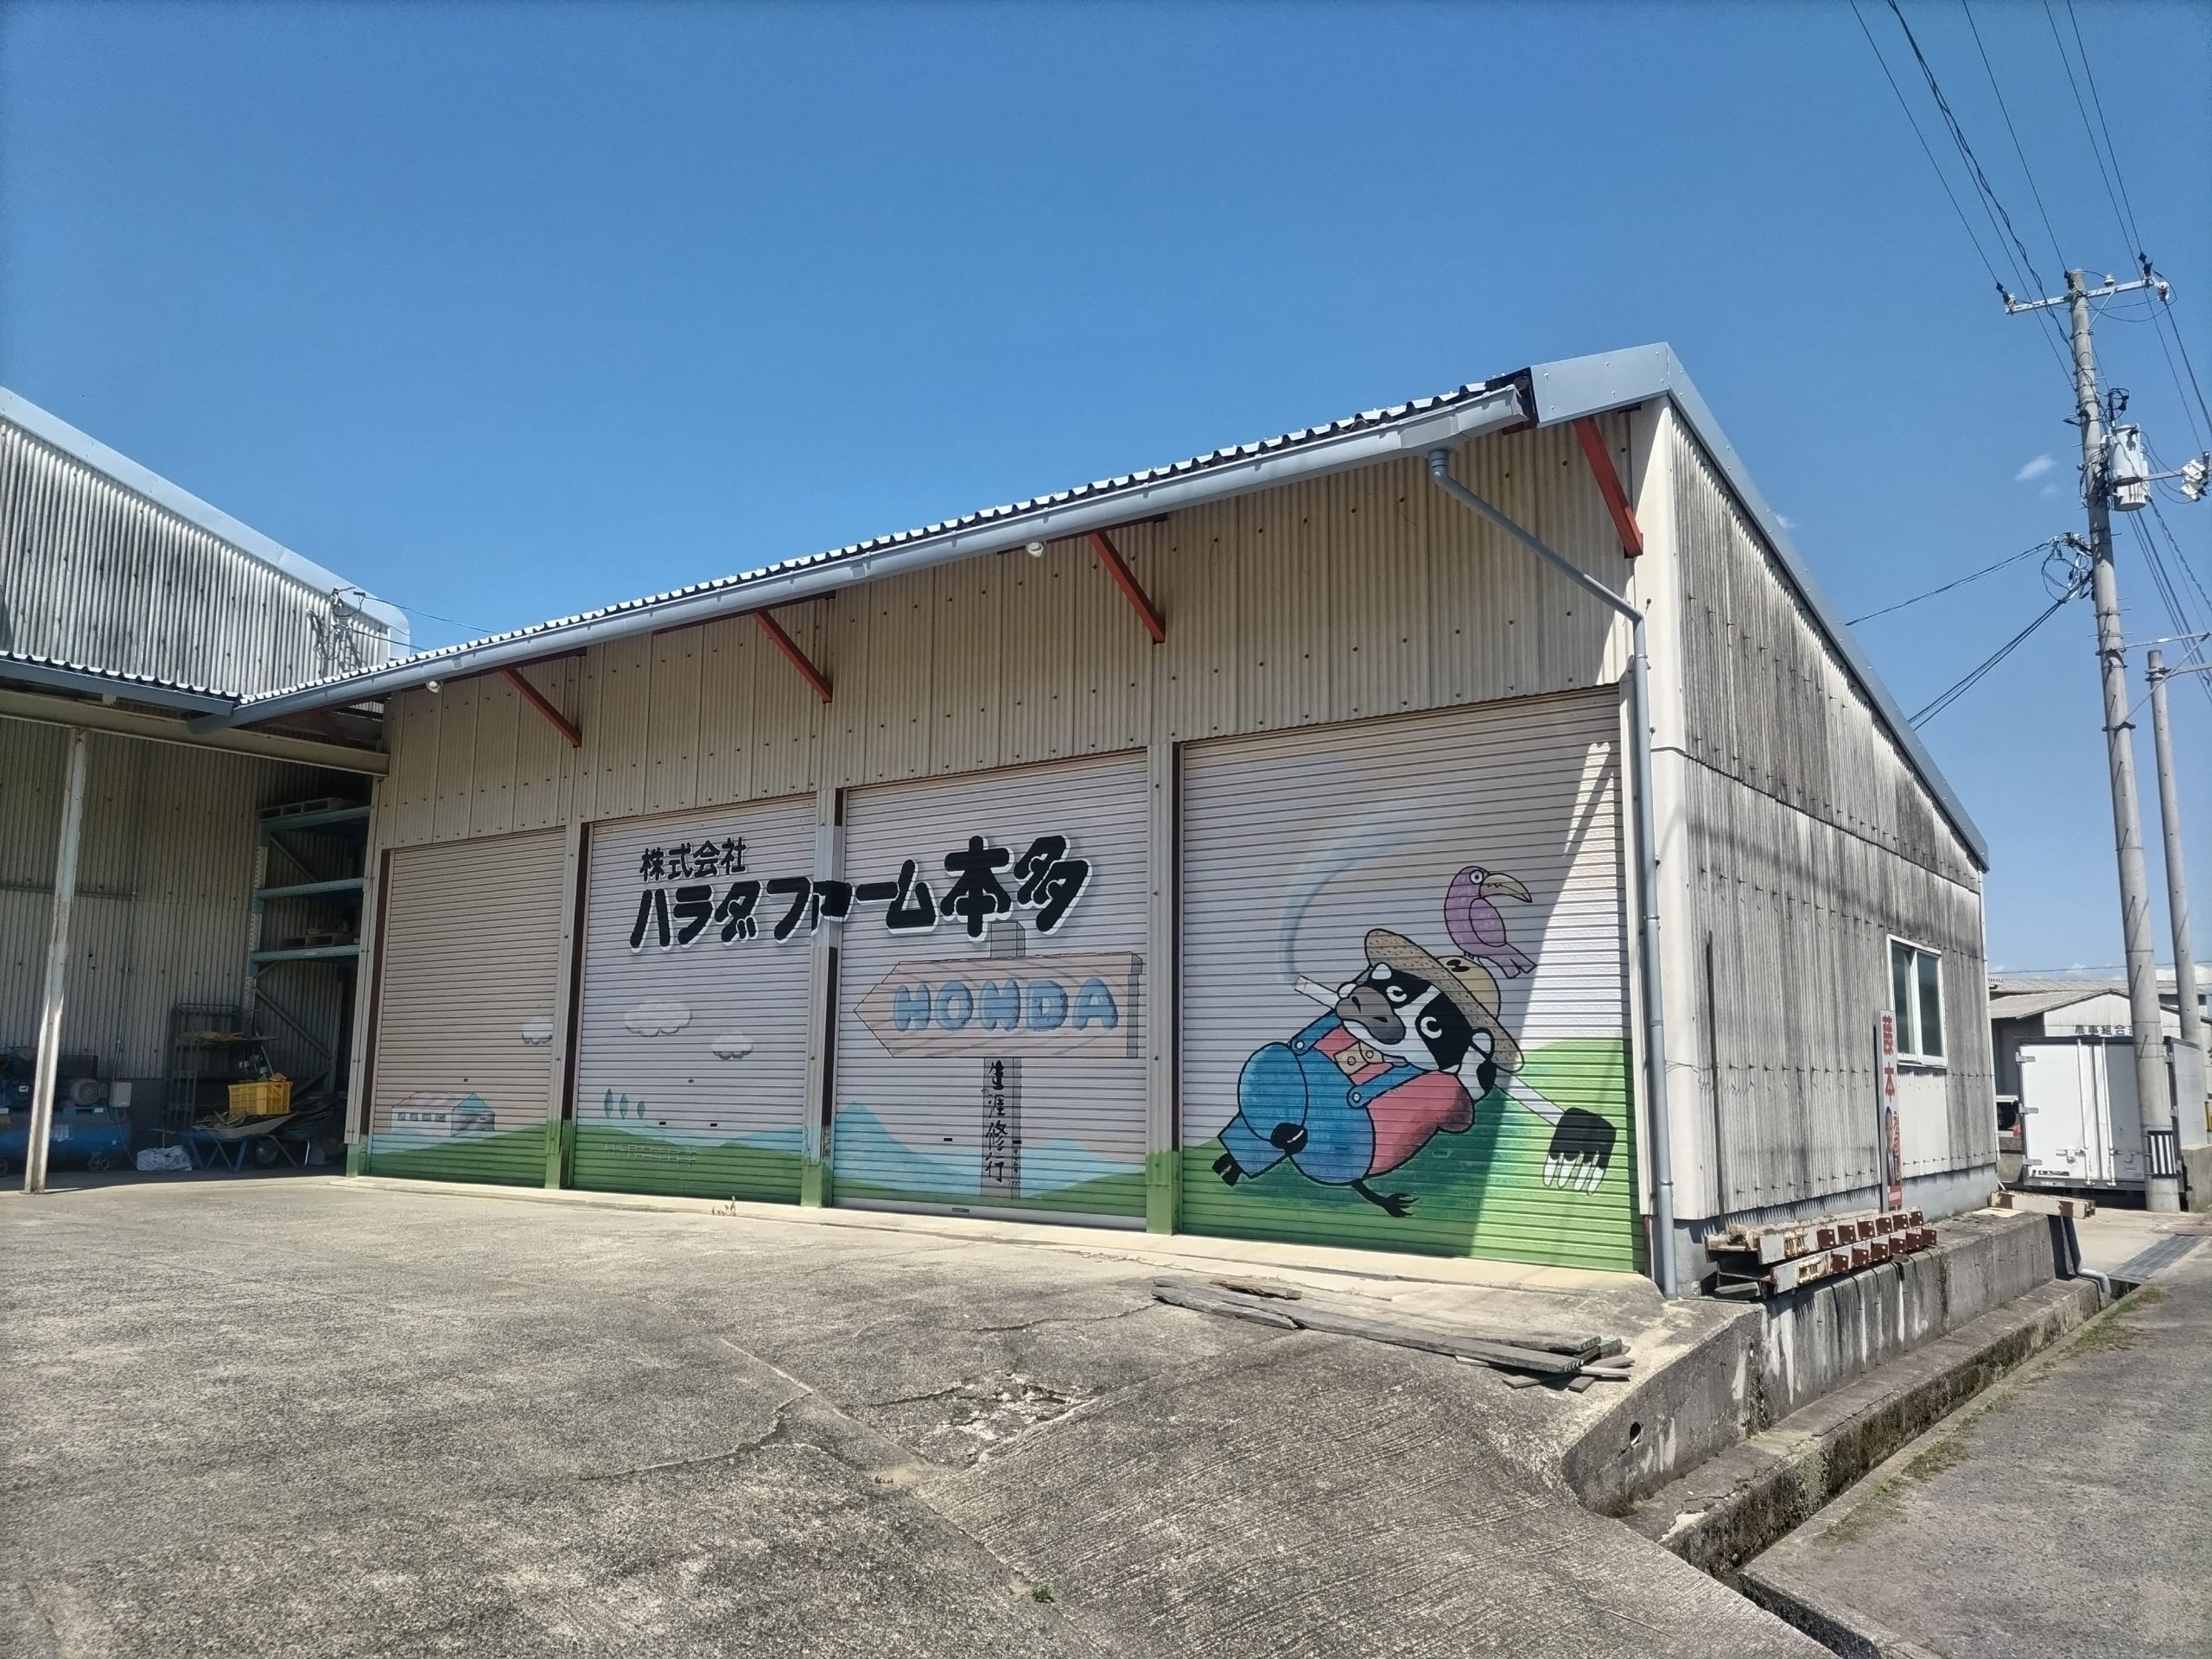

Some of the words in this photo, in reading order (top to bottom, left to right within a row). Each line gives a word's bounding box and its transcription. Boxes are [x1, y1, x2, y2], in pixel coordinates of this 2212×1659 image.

[629, 835, 1092, 952] ハラダファーム本多
[639, 836, 747, 882] 株式会社
[893, 977, 1119, 1032] HONDA
[985, 1059, 1008, 1183] 生涯修行
